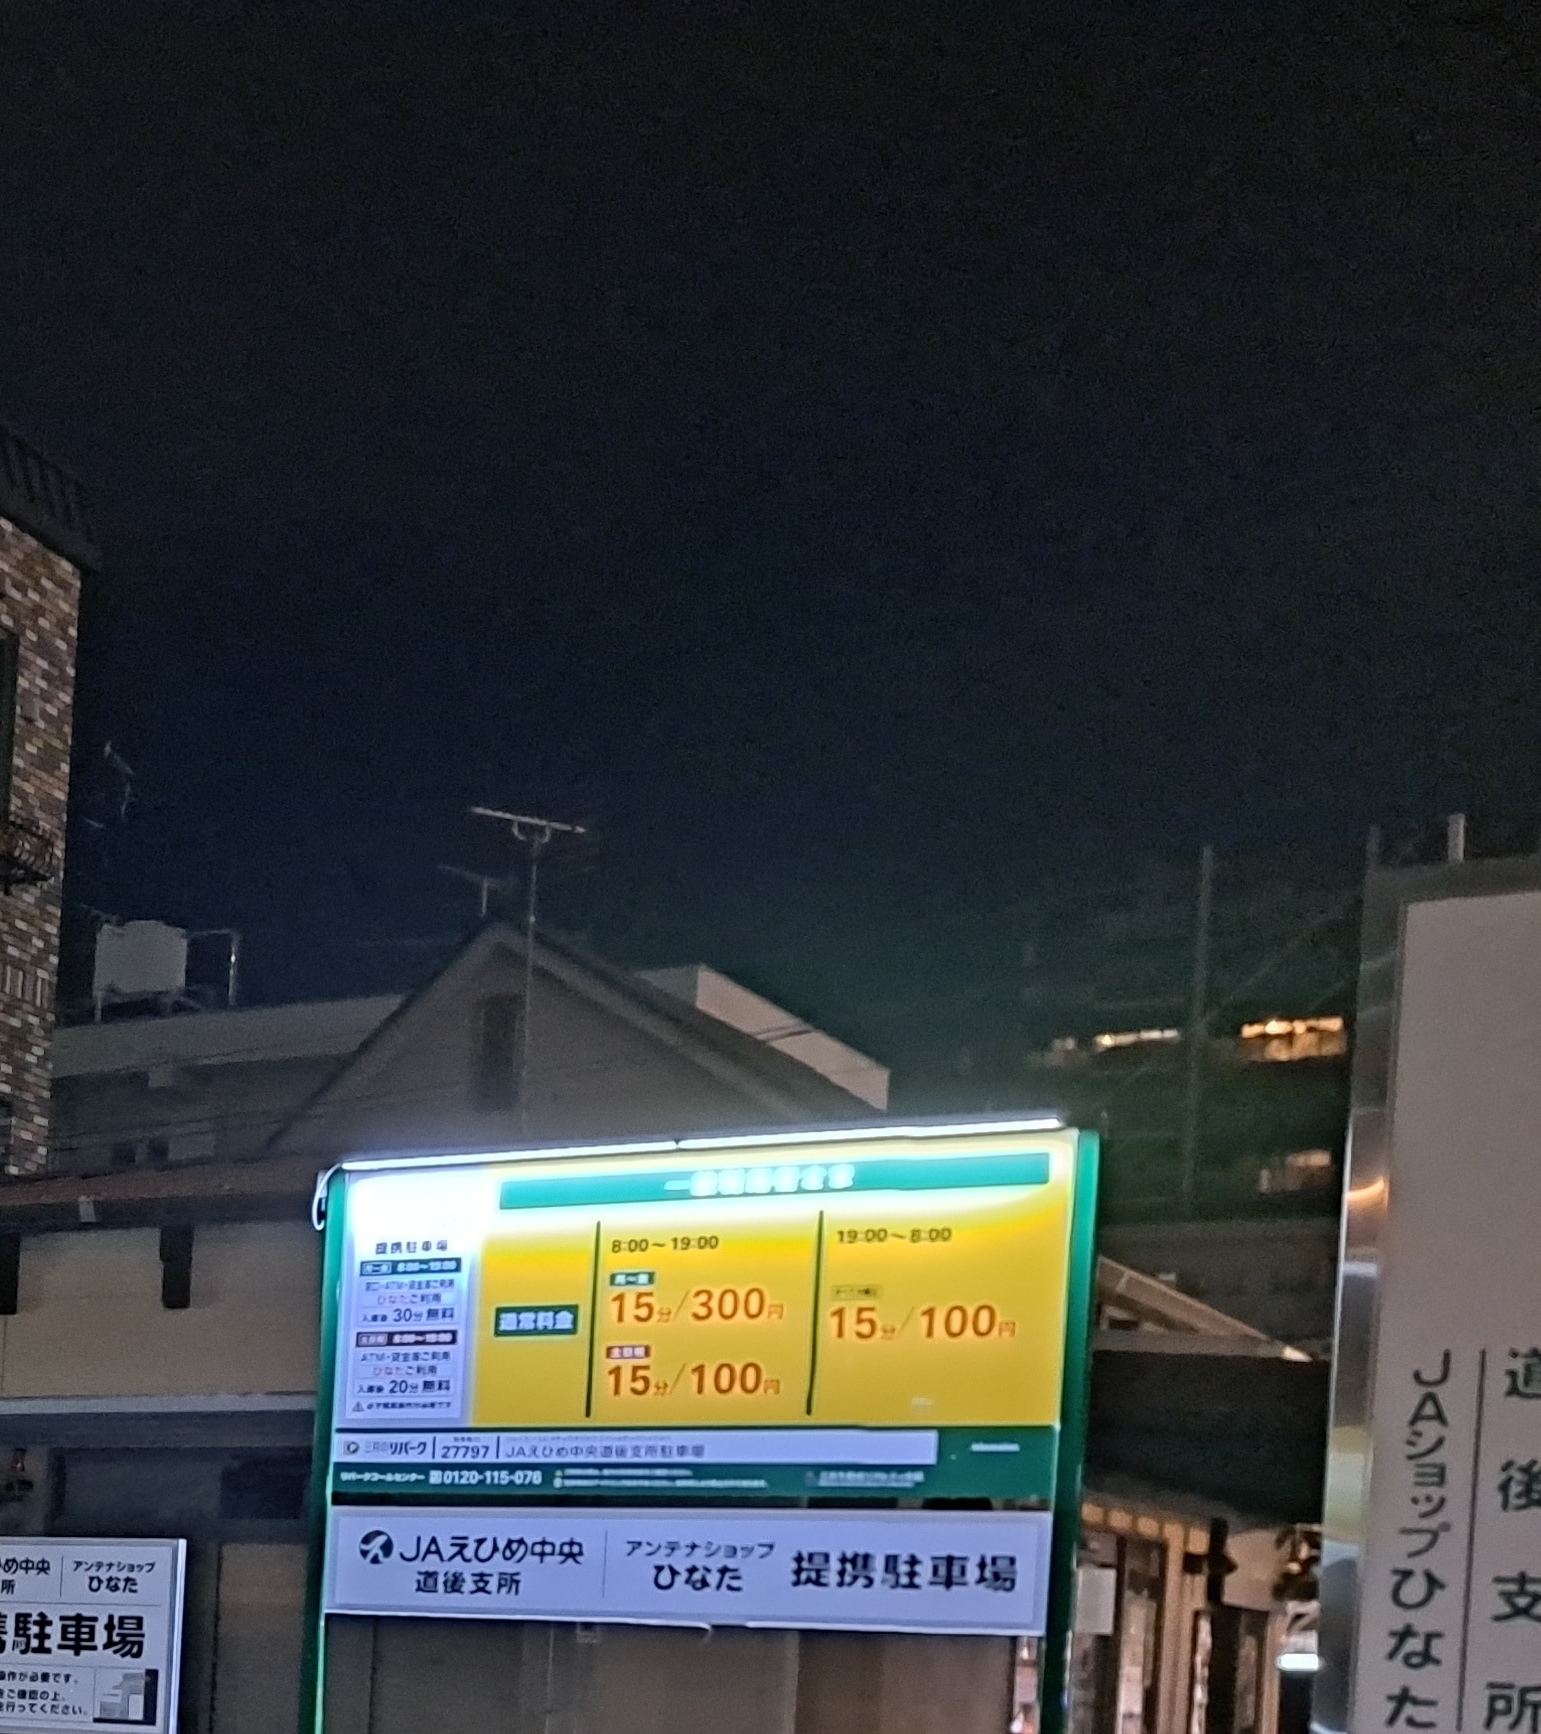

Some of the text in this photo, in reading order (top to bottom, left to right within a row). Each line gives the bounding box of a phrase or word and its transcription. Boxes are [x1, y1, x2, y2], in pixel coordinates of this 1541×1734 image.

[441, 1445, 490, 1459] 27797
[400, 1536, 584, 1566] JAえひめ中央
[625, 1540, 775, 1560] アンテナショップ
[1384, 1348, 1452, 1730] JAショップひなた
[73, 1560, 155, 1573] アンテナショップ
[653, 1564, 743, 1592] ひなた
[791, 1550, 1017, 1593] 提携駐車場
[88, 1576, 139, 1594] ひなた
[415, 1571, 522, 1596] 道後支所
